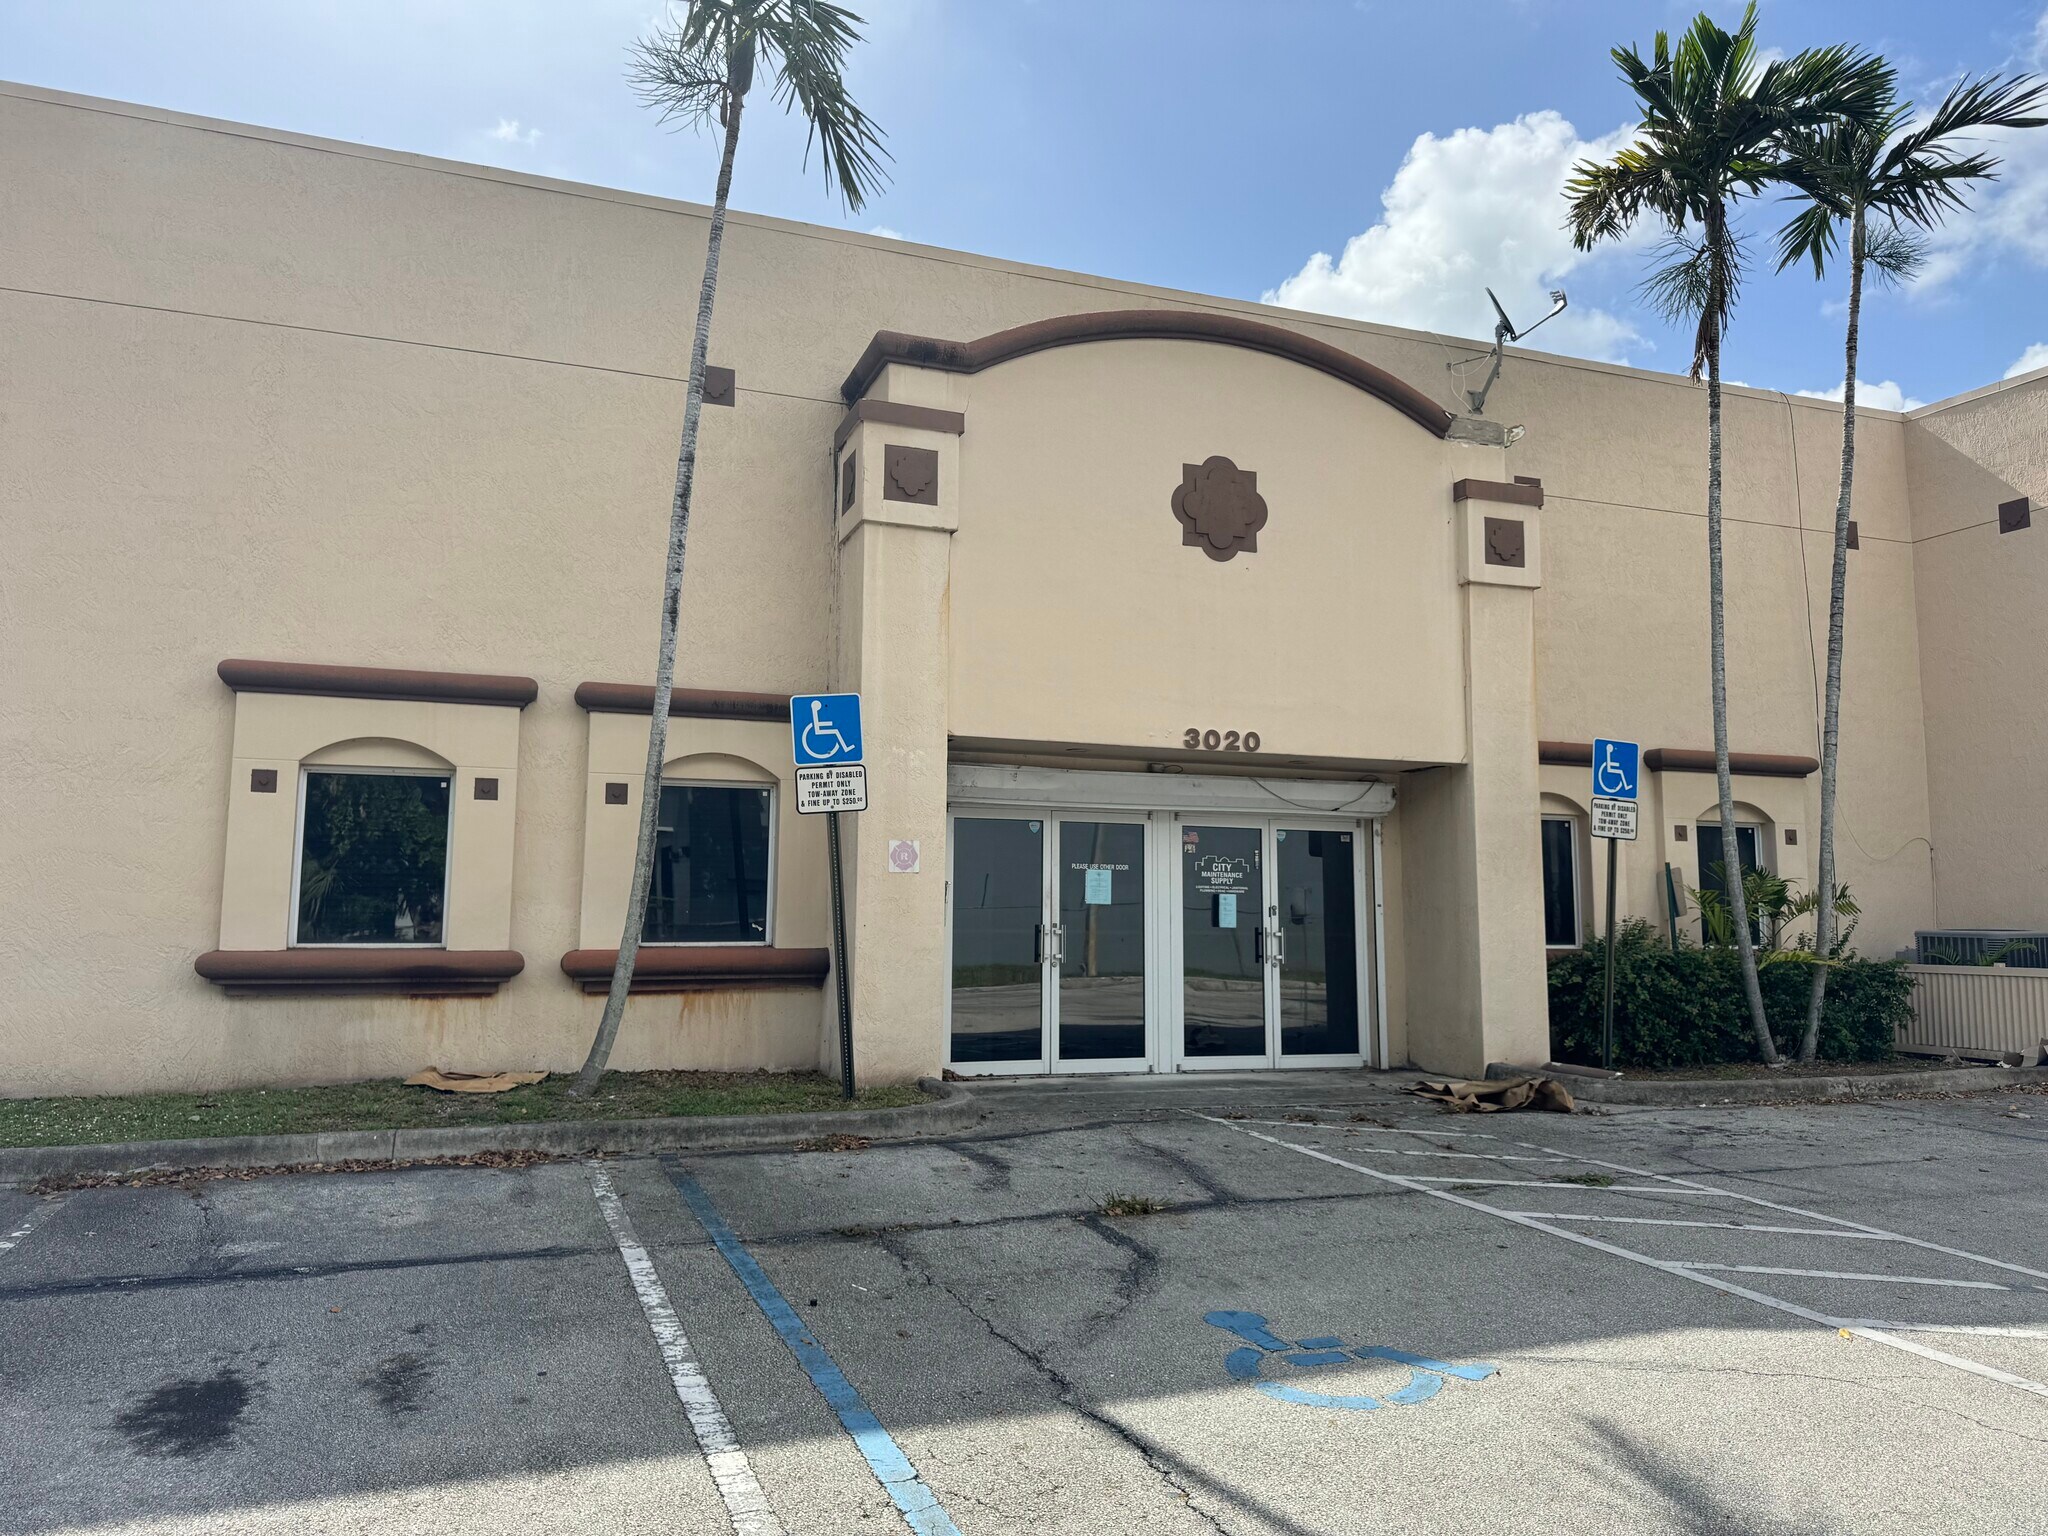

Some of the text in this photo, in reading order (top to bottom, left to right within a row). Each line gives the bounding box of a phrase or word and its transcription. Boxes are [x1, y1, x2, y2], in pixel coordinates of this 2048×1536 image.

[1183, 728, 1261, 752] 3020
[835, 771, 863, 779] DISABLED
[837, 780, 851, 788] ONLY
[808, 790, 838, 798] TOW-AWAY
[808, 799, 820, 807] FINE
[1212, 863, 1232, 871] CITY
